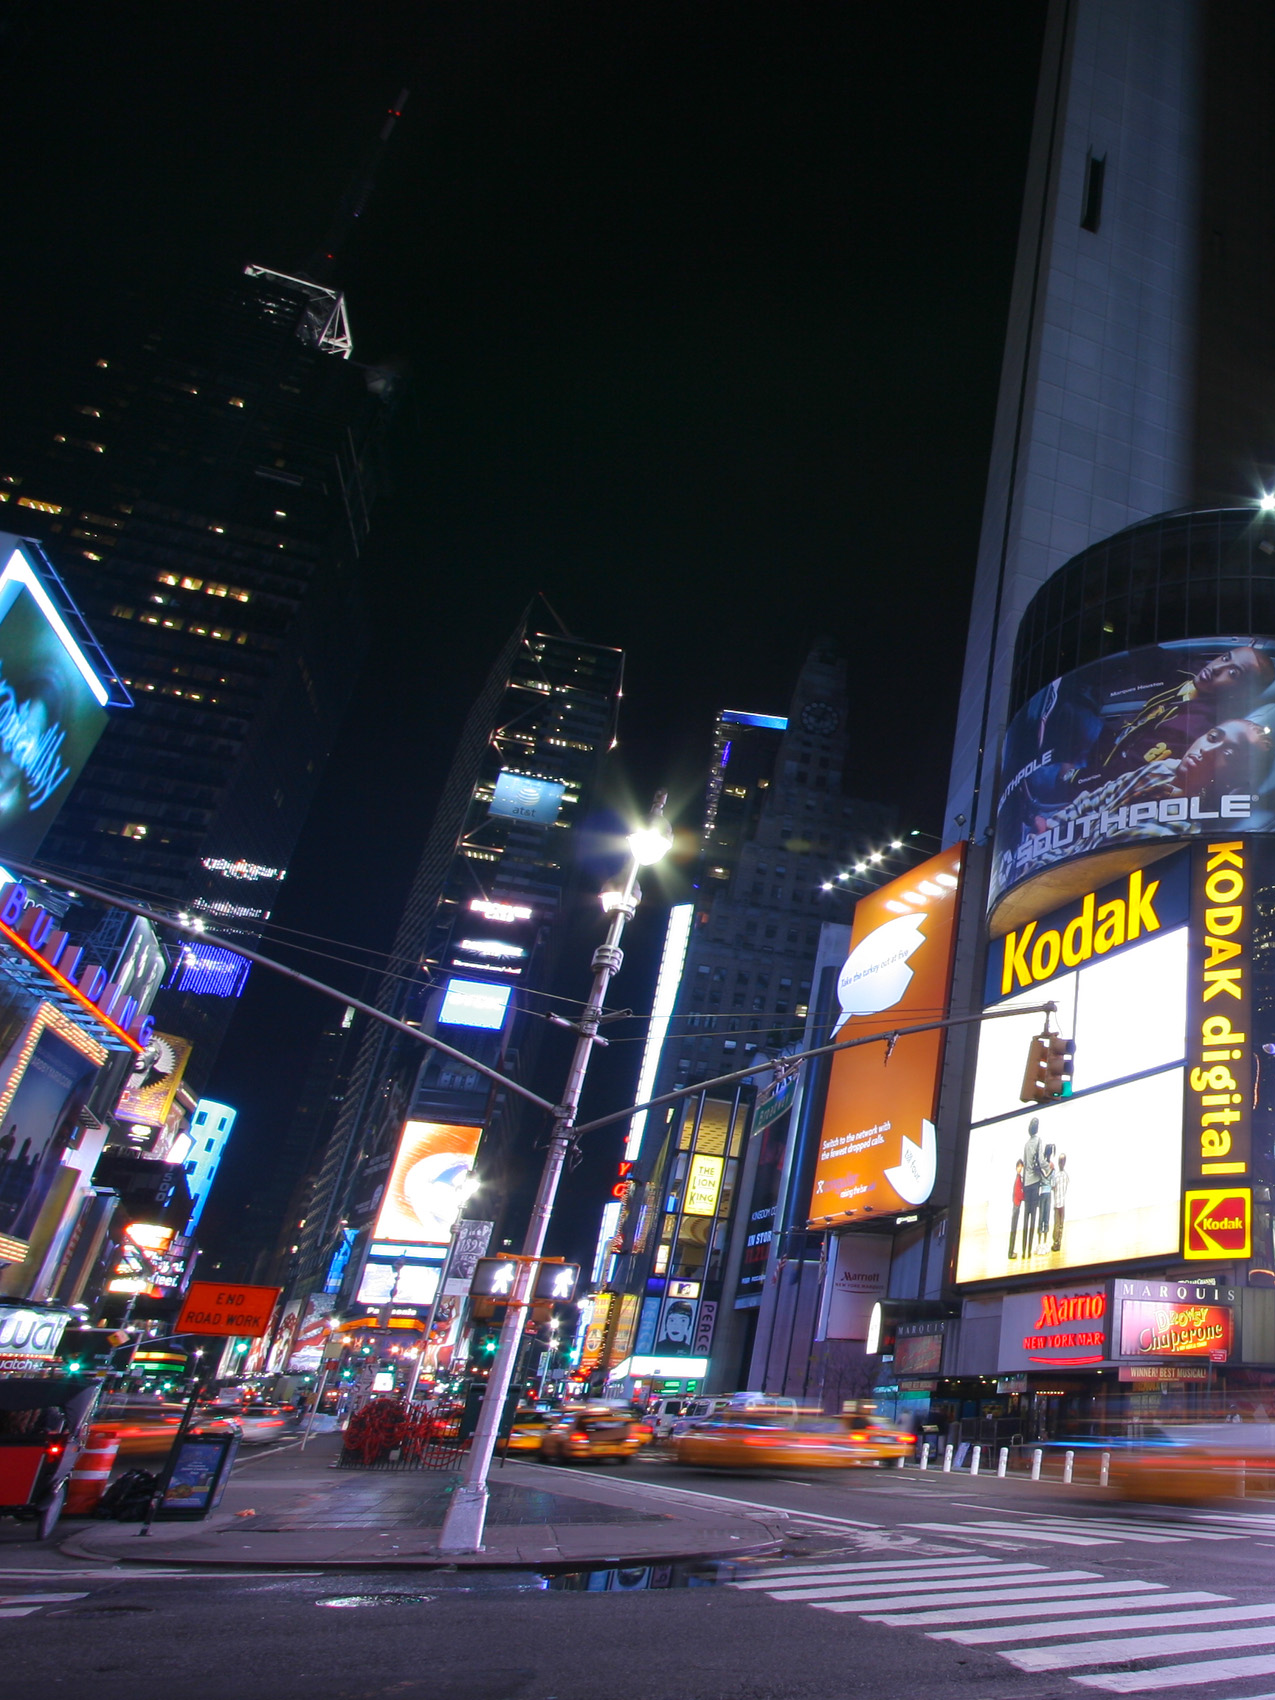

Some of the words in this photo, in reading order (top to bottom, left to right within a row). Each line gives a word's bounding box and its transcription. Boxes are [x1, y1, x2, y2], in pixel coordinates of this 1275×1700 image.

[1109, 683, 1136, 697] Marques
[1137, 680, 1165, 692] Houston
[512, 806, 537, 818] at&t
[1016, 794, 1251, 865] SOUTHPOLE
[1203, 840, 1245, 1003] KODAK
[1001, 869, 1161, 996] Kodak
[1190, 1015, 1247, 1176] digital
[699, 1165, 715, 1176] THE
[692, 1175, 716, 1191] LION
[689, 1191, 714, 1206] KING
[1202, 1215, 1243, 1232] Kodak
[755, 1230, 772, 1246] STOR
[840, 1271, 880, 1282] Marriott
[216, 1293, 246, 1306] END
[1122, 1283, 1235, 1301] MARQUIS
[185, 1311, 221, 1326] ROAD
[225, 1313, 262, 1328] WORK
[1034, 1292, 1108, 1330] Marrio
[698, 1303, 715, 1354] PEACE
[1153, 1306, 1210, 1334] DROWSY
[1023, 1334, 1045, 1350] NEW
[1047, 1332, 1076, 1349] YORK
[1078, 1331, 1106, 1346] MAR
[1138, 1323, 1223, 1353] Chaperone
[1131, 1366, 1158, 1378] WINNER!
[1159, 1366, 1176, 1378] BEST
[1177, 1367, 1207, 1379] MUSICAL!
